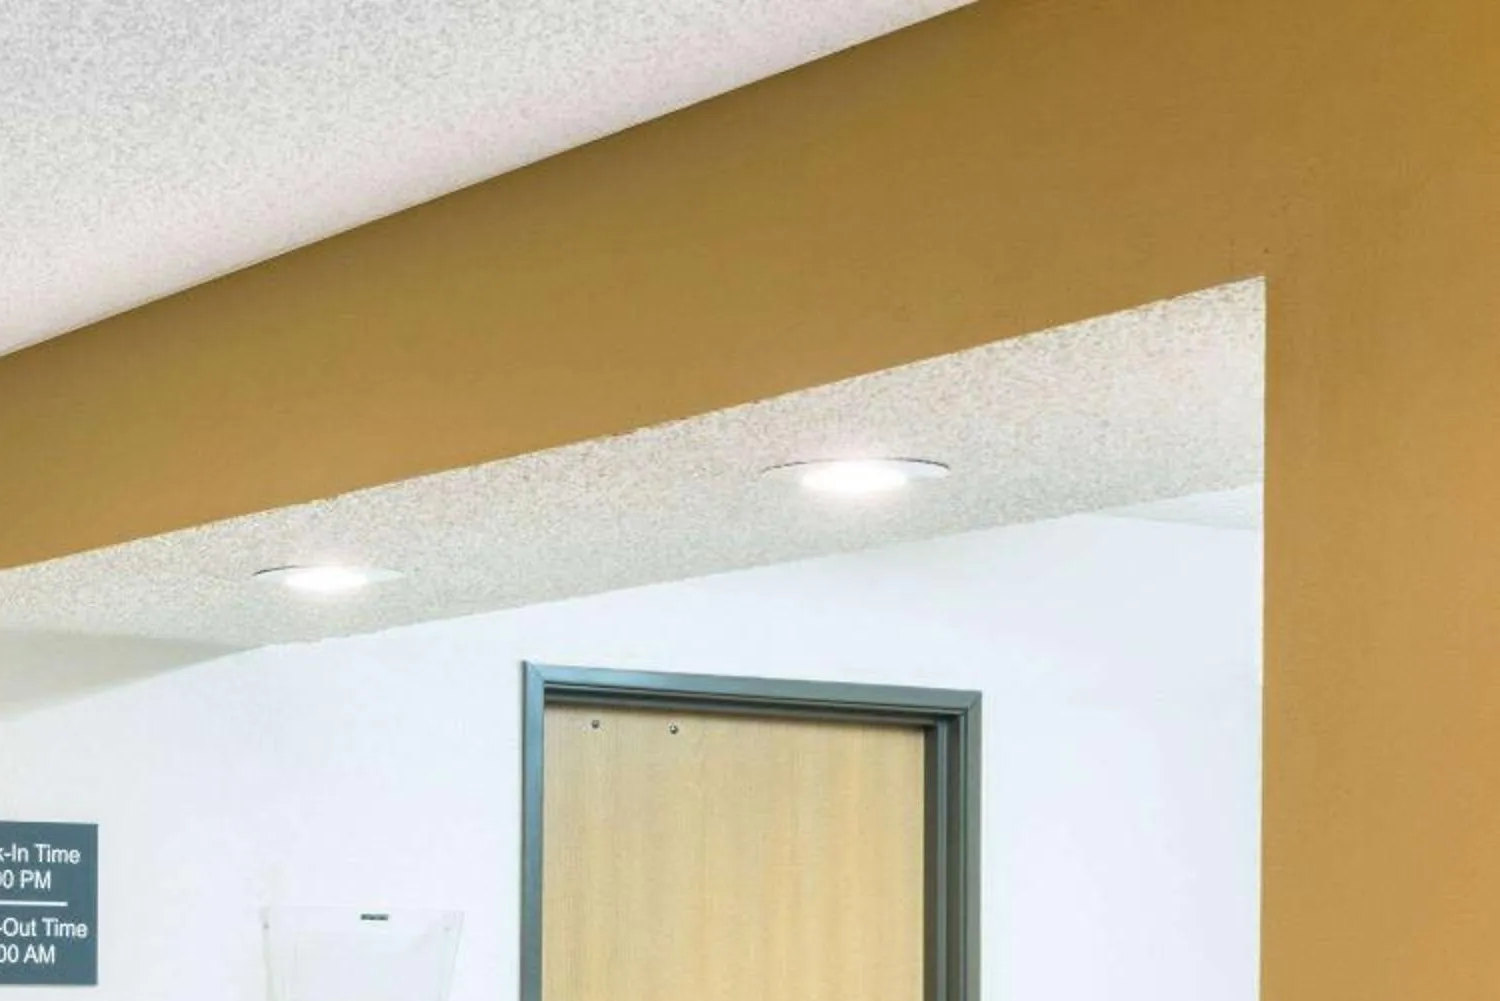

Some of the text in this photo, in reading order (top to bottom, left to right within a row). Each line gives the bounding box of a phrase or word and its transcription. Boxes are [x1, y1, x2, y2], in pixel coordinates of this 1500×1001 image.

[34, 844, 81, 864] Time
[20, 870, 52, 890] PM
[42, 918, 88, 938] Time
[24, 944, 56, 964] AM
